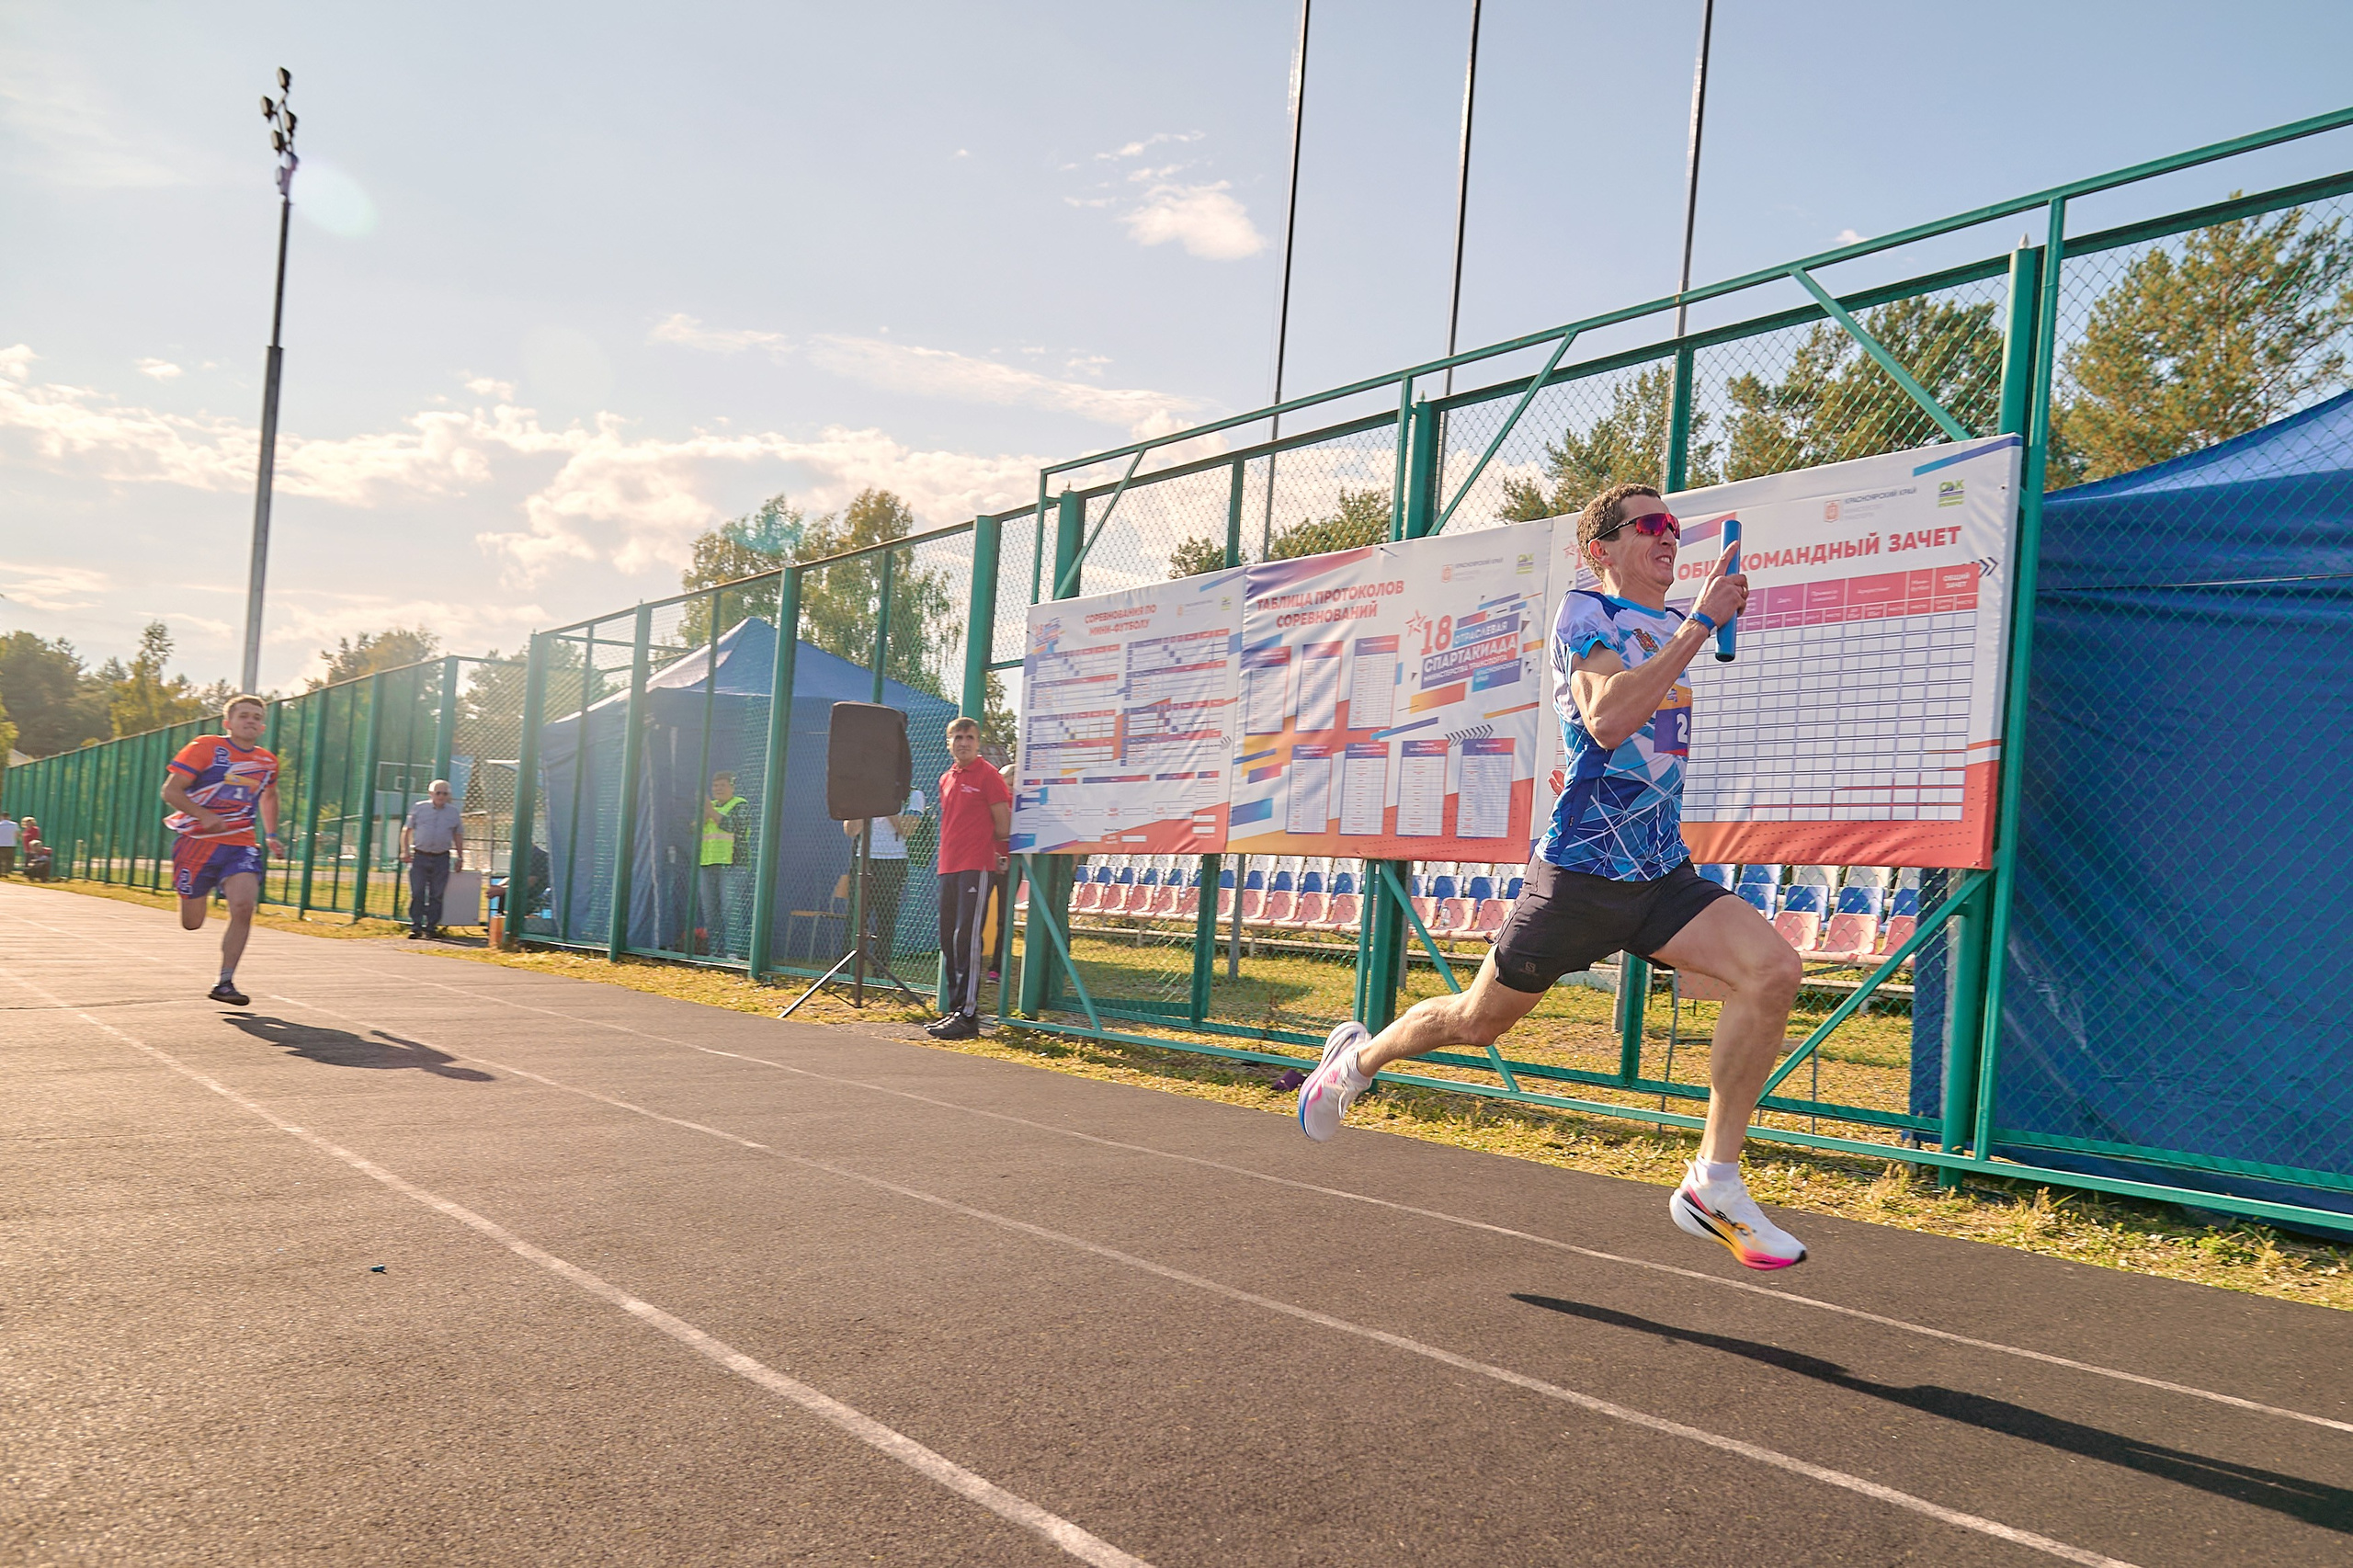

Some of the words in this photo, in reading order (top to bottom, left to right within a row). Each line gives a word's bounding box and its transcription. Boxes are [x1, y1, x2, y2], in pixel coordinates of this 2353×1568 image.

[1889, 526, 1962, 551] ЗАЧЕТ
[1256, 592, 1313, 612] ТАБЛИЦА
[1314, 580, 1404, 605] ПРОТОКОЛОВ
[1084, 605, 1143, 625] СОРЕВНОВАНИЯ
[1144, 604, 1157, 615] ПО
[1088, 619, 1152, 637] МИНИ-ФУТБОЛУ
[1276, 600, 1379, 629] СОРЕВНОВАНИЙ
[1420, 615, 1452, 656] 18
[1454, 620, 1509, 644] ОТРАСЛЕВАЯ
[1424, 634, 1518, 673] СПАРТАКИАДА
[1423, 665, 1469, 683] МИНИСТЕРСТВА
[1469, 654, 1508, 670] ТРАНСПОРТА
[1677, 712, 1688, 744] 2
[233, 787, 244, 800] 1
